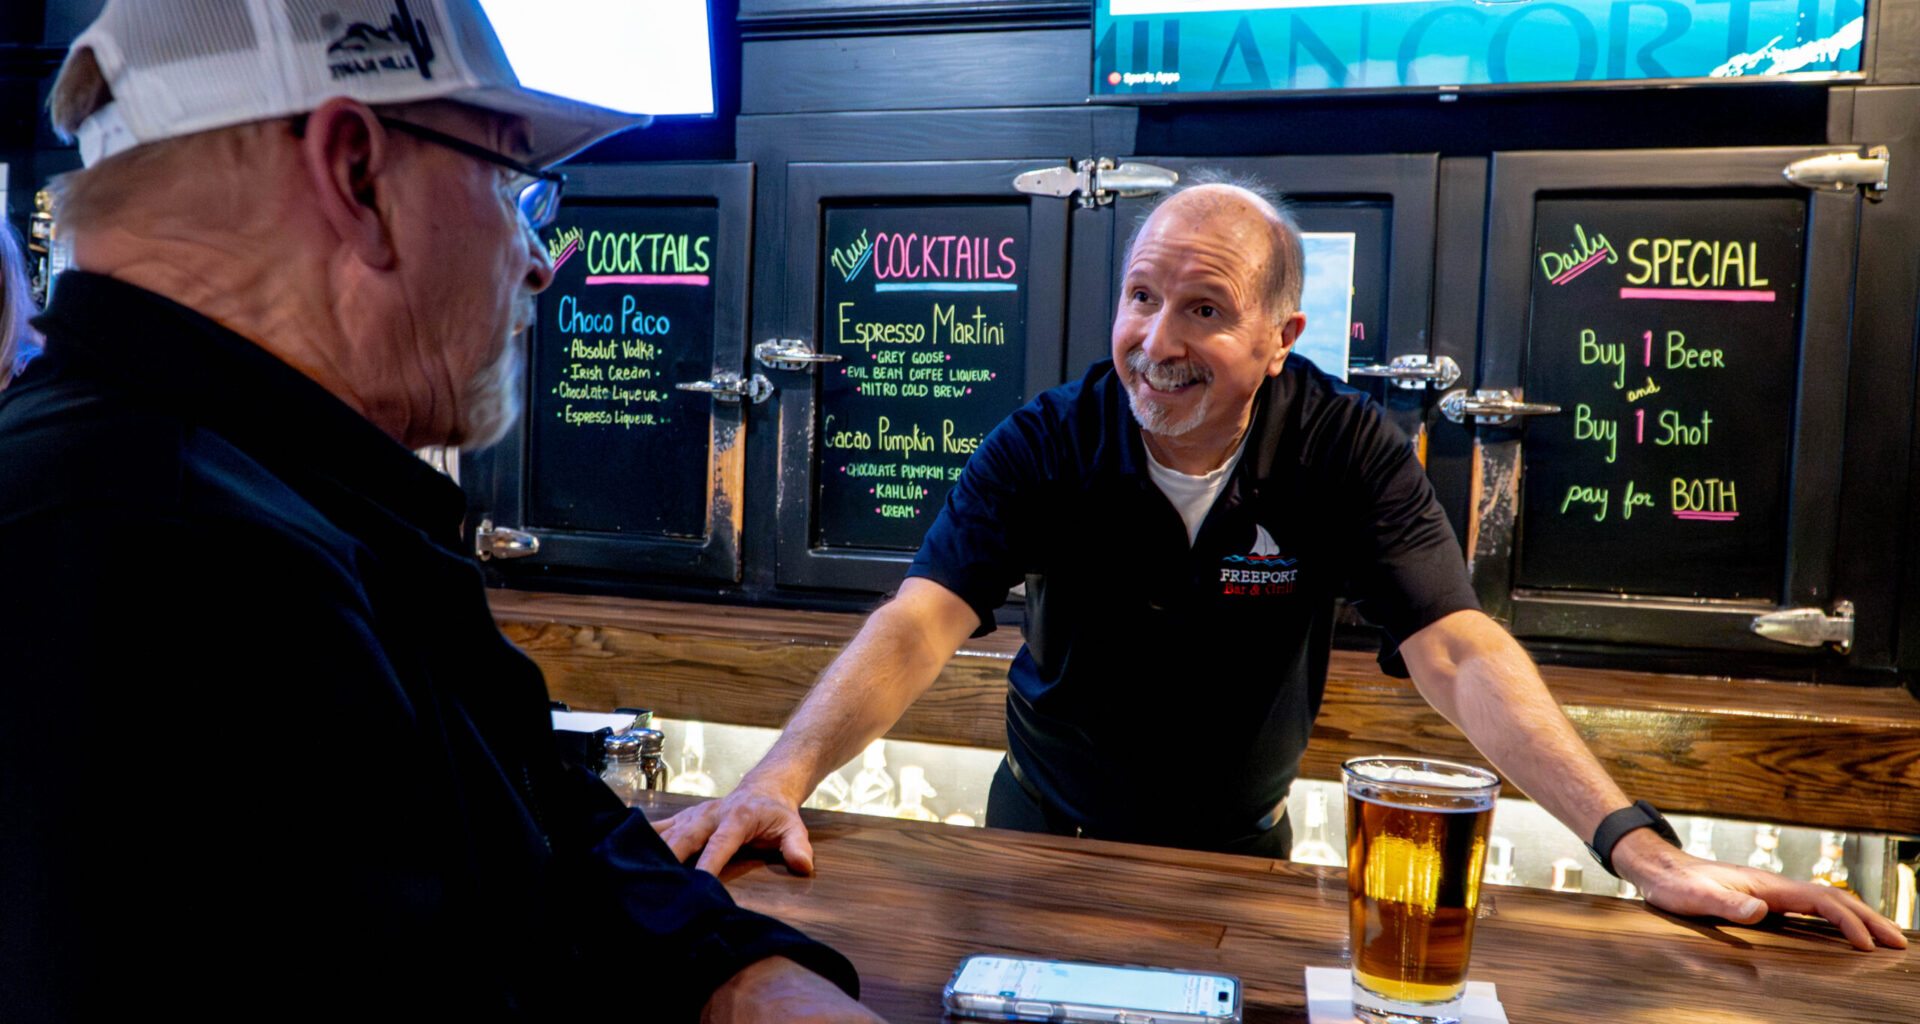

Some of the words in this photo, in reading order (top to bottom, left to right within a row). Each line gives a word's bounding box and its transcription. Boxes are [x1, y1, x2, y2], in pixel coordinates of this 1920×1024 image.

[549, 226, 585, 259] oliday
[587, 230, 710, 274] COCKTAILS
[831, 228, 869, 278] New
[873, 232, 1016, 280] COCKTAILS
[1540, 224, 1618, 280] Daily
[1626, 238, 1768, 287] SPECIAL
[558, 294, 614, 333] Choco
[620, 294, 670, 335] Paco
[839, 302, 925, 351] Espresso
[933, 303, 1004, 345] Martini
[570, 338, 618, 360] Absolut
[622, 338, 655, 360] Vodka
[877, 350, 906, 364] GREY
[911, 351, 944, 364] GOOSE
[1580, 329, 1625, 389] Buy
[1643, 330, 1652, 367] 1
[1666, 330, 1725, 369] Beer
[847, 366, 869, 378] EVIL
[873, 366, 903, 380] BEAN
[909, 368, 943, 381] COFFEE
[950, 369, 991, 382] LIQUEUR
[559, 381, 609, 400] Chocolate
[861, 382, 897, 396] NITRO
[901, 384, 928, 397] COLD
[934, 385, 966, 398] BREW
[1627, 376, 1660, 402] and
[825, 414, 871, 449] Cacao
[878, 416, 934, 459] Pumpkin
[943, 419, 983, 454] Russi
[1574, 403, 1617, 463] Buy
[1635, 408, 1644, 444] 1
[1655, 410, 1713, 445] Shot
[846, 463, 897, 477] CHOCOLATE
[901, 464, 943, 480] PUMPKIN
[948, 467, 962, 482] SP
[876, 481, 923, 500] KAHLÚA
[1561, 485, 1608, 522] pay
[1624, 480, 1654, 520] for
[1671, 477, 1737, 512] BOTH
[881, 504, 914, 518] CREAM
[1219, 568, 1298, 583] FREEPORT
[1223, 582, 1247, 595] Bar
[1249, 583, 1260, 596] &
